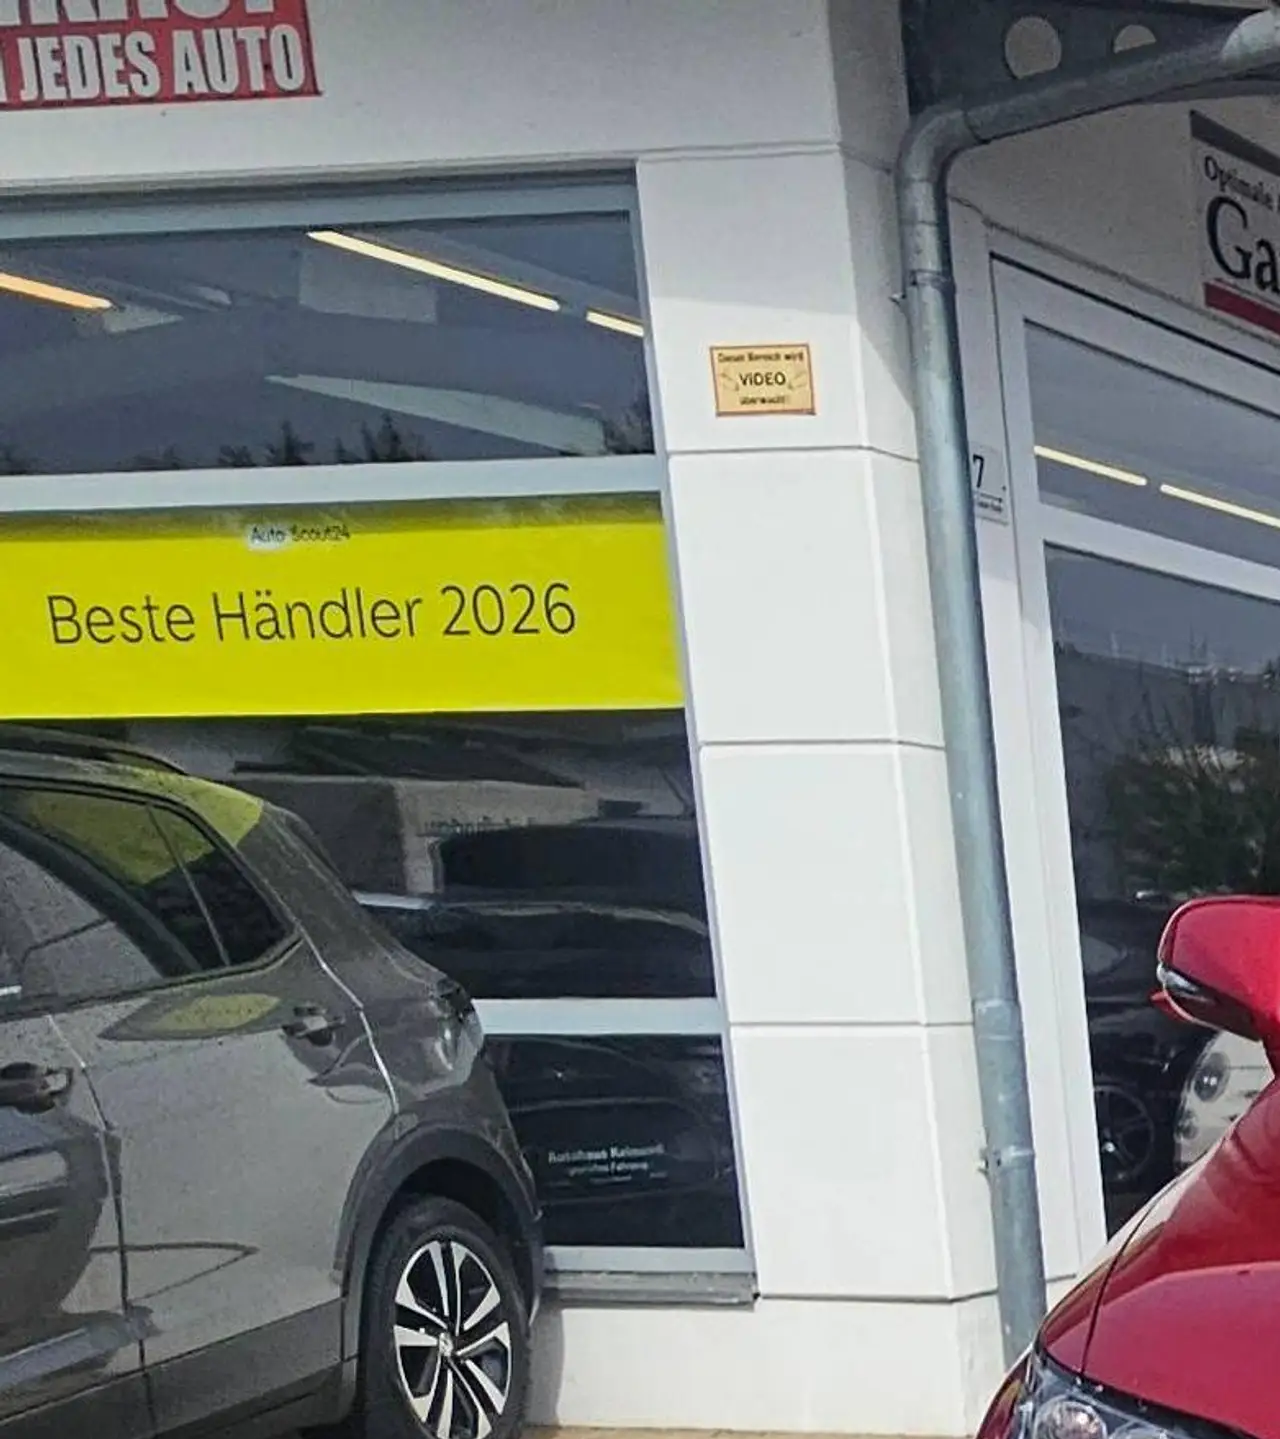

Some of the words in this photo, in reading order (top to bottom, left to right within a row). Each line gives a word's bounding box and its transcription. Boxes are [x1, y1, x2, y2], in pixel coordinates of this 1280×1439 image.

[17, 31, 162, 102] JEDES
[172, 23, 305, 95] AUTO
[47, 594, 196, 645] Beste
[212, 589, 423, 642] Händler
[440, 582, 577, 637] 2026
